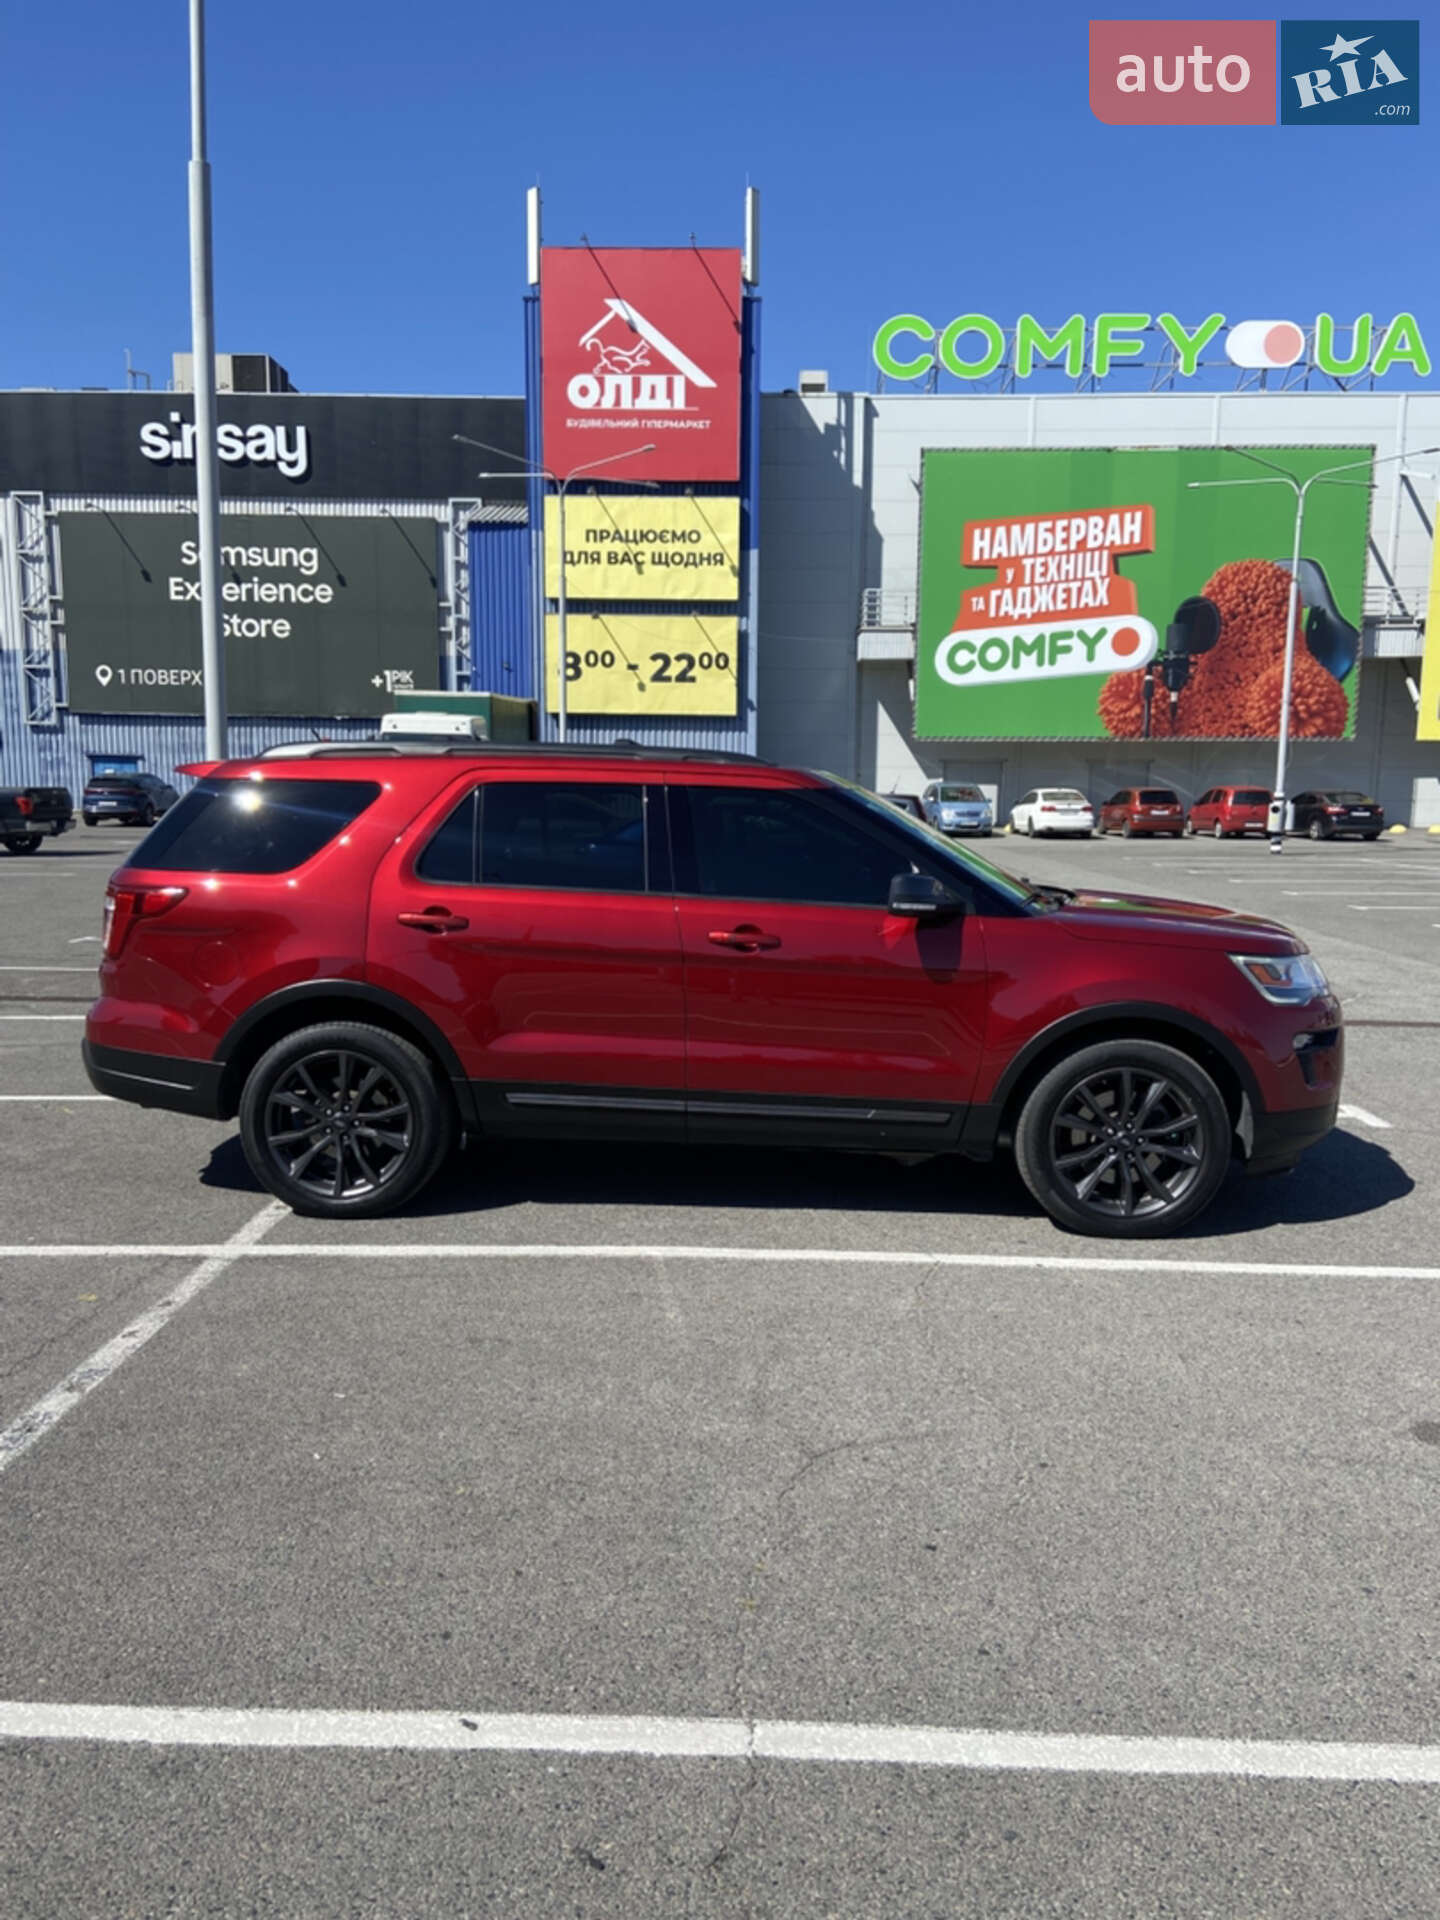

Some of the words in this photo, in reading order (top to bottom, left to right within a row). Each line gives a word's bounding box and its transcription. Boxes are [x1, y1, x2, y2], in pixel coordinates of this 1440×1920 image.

[872, 312, 1226, 381] COMFY
[1315, 311, 1432, 377] UA
[567, 373, 686, 410] ОЛДІ
[585, 528, 701, 545] ПРАЦЮЄМО
[972, 511, 1142, 561] НАМБЕРВАН
[181, 541, 318, 575] Smsung
[563, 550, 601, 567] ДЛЯ
[607, 551, 645, 566] ВАС
[651, 552, 724, 567] ЩОДНЯ
[1022, 549, 1109, 585] ТЕХНІЦІ
[168, 576, 334, 604] Exerience
[989, 577, 1110, 619] ГАДЖЕТАХ
[946, 627, 1108, 675] COMFY
[130, 668, 203, 686] ПОВЕРХ
